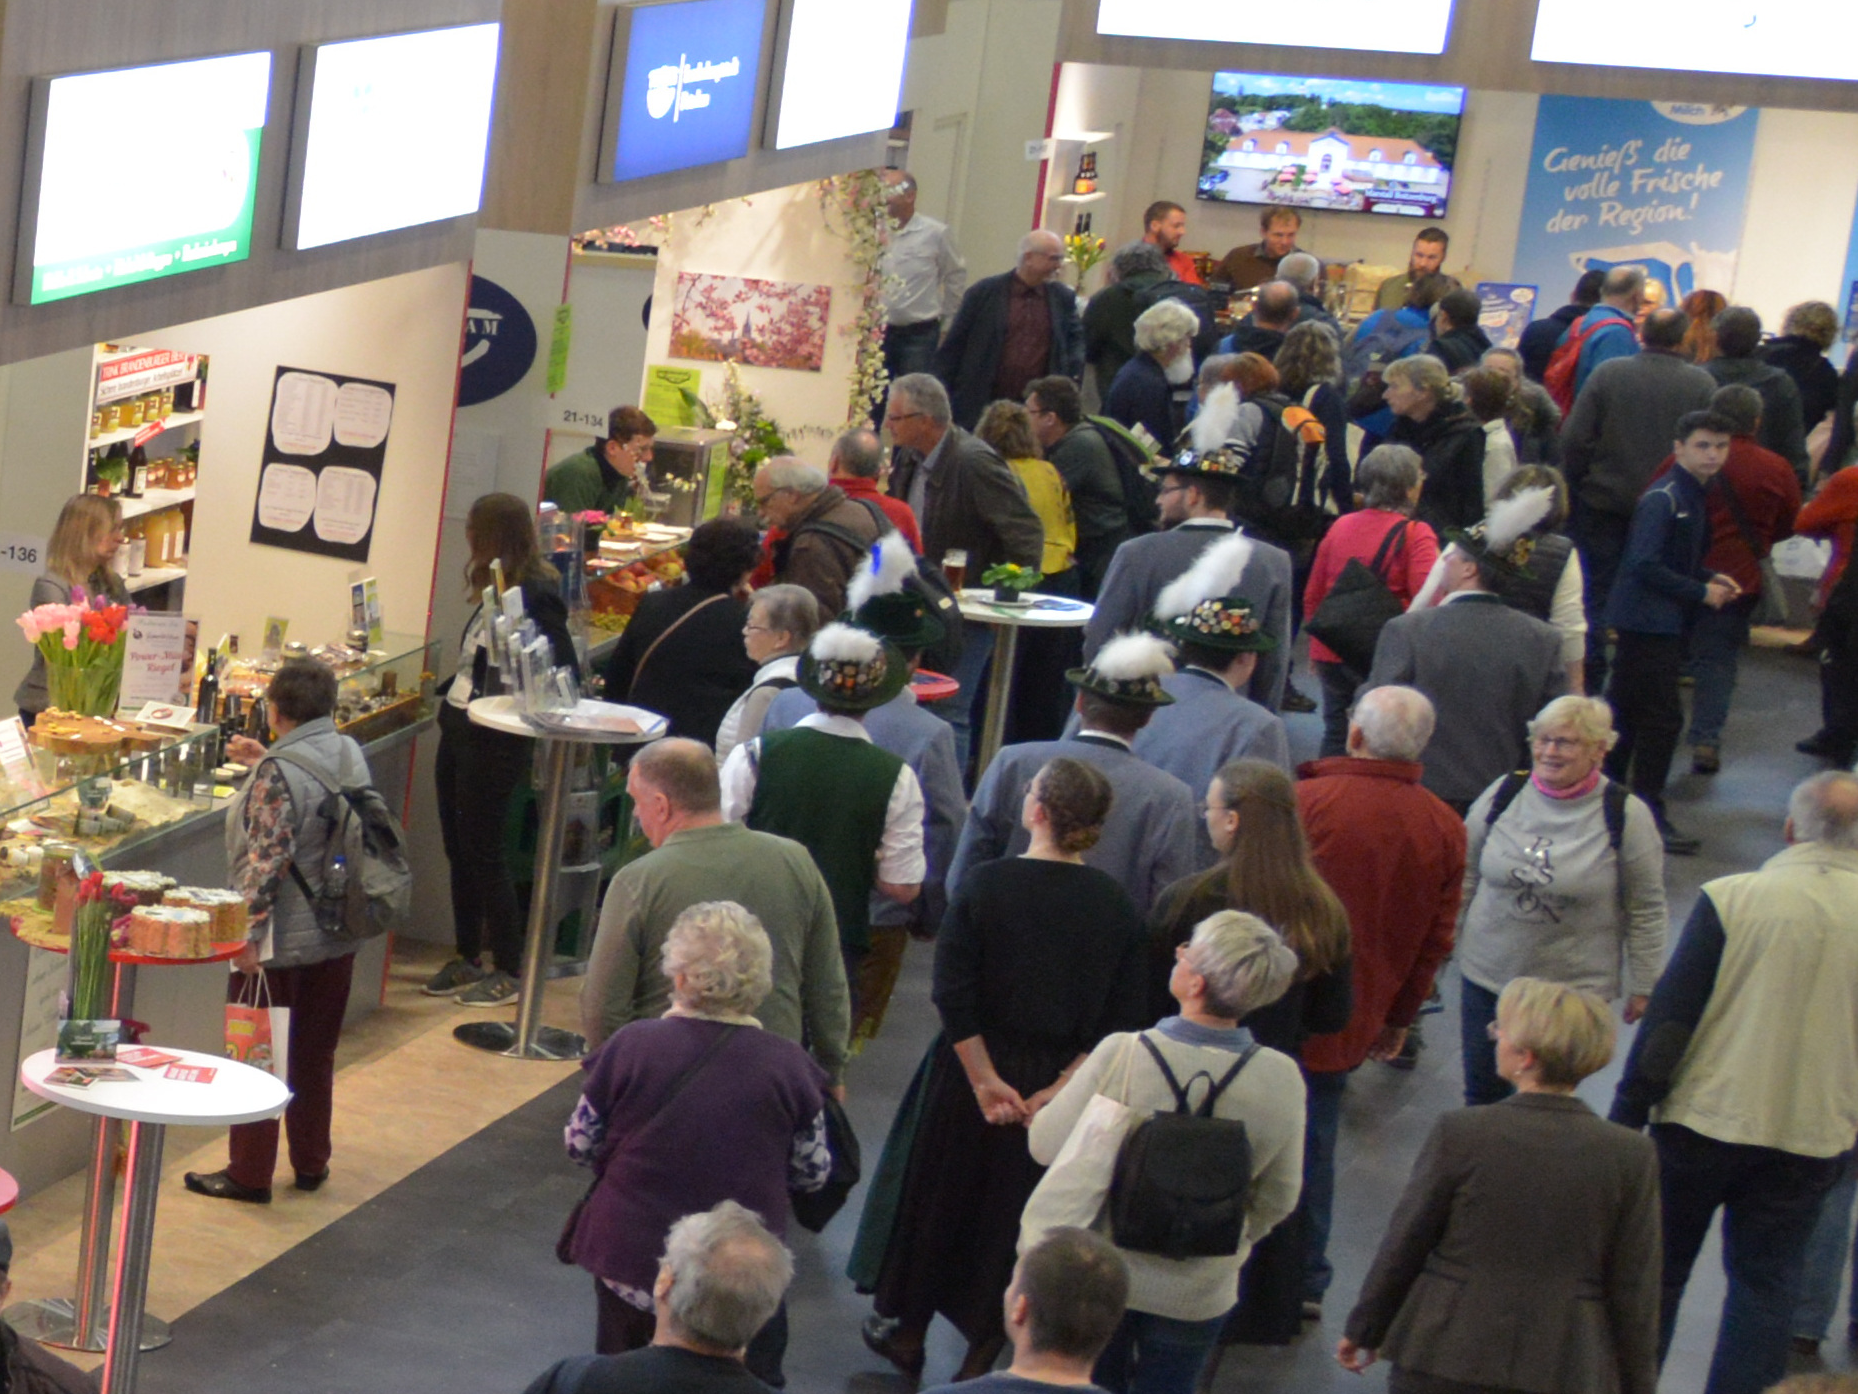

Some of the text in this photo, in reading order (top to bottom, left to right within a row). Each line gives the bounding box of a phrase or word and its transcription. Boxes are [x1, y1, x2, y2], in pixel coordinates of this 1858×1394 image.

[1544, 135, 1693, 174] Genieß die
[1565, 163, 1724, 201] volle Frische
[1546, 192, 1700, 235] der Region!
[563, 410, 603, 428] 21-134
